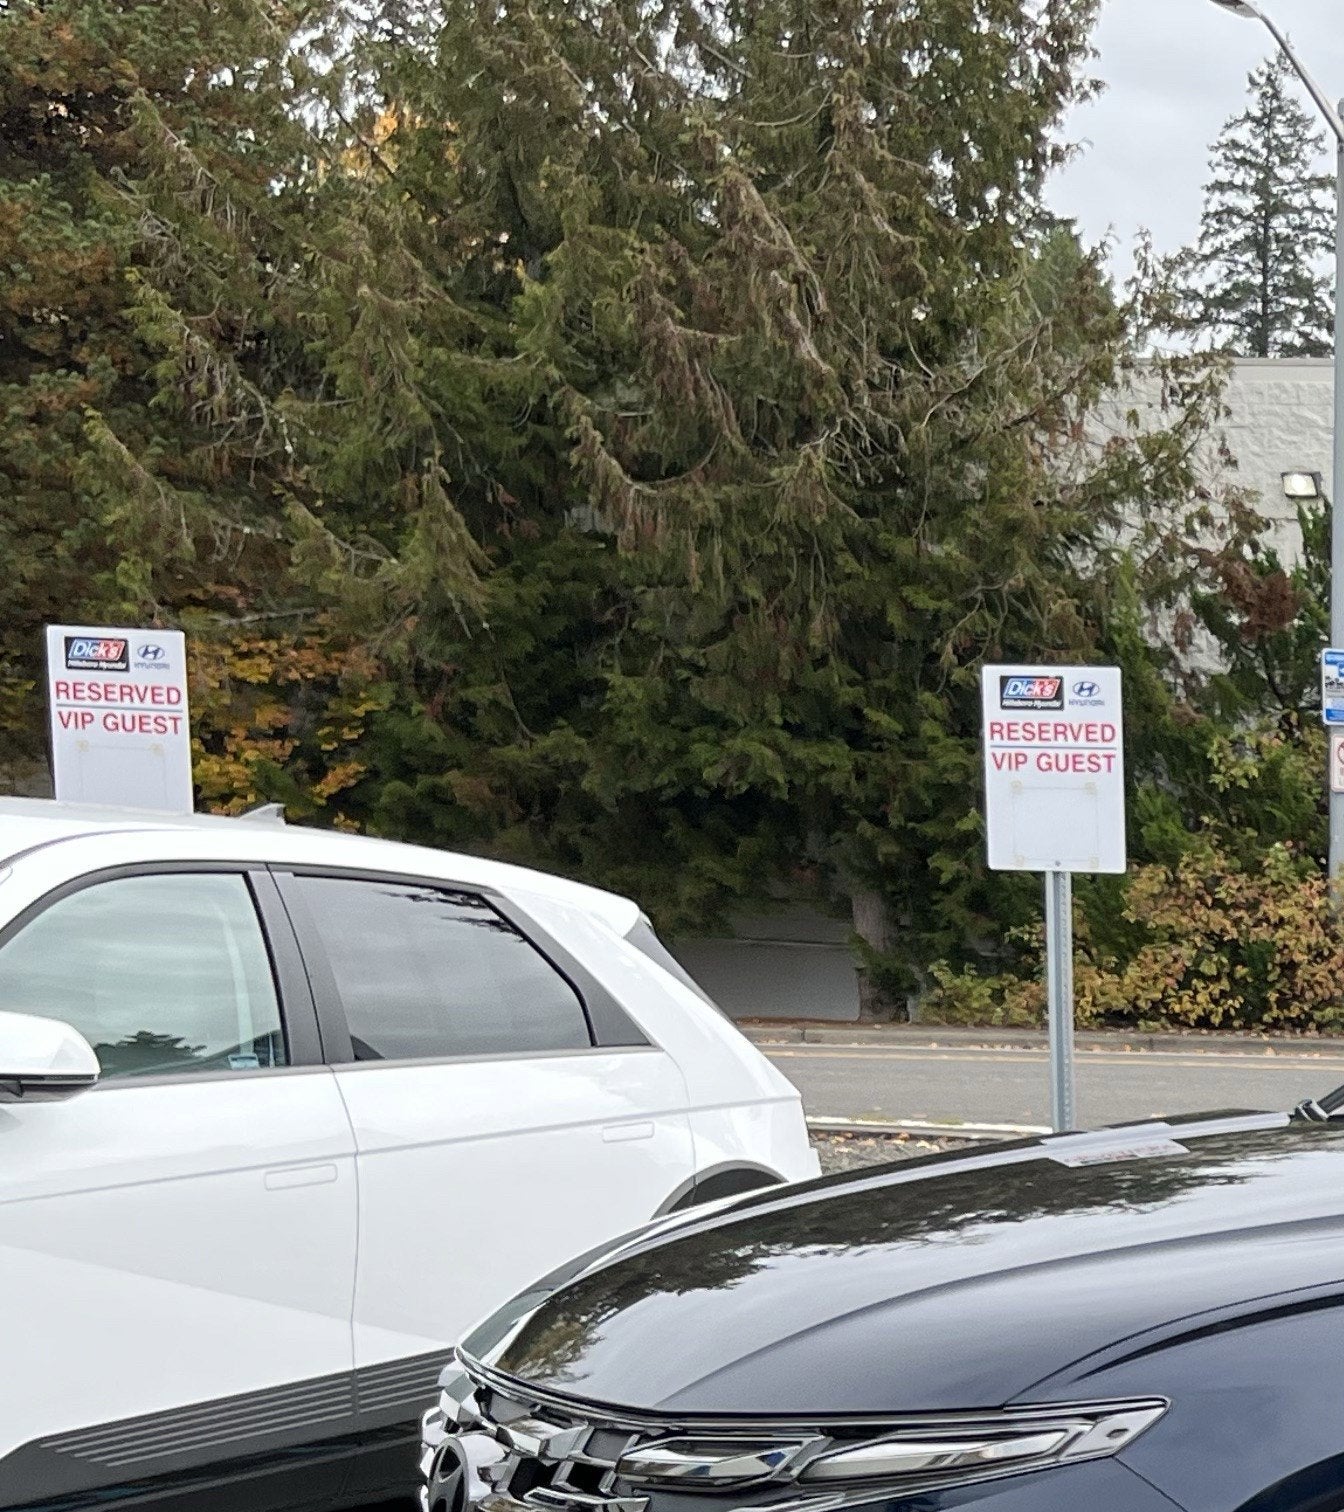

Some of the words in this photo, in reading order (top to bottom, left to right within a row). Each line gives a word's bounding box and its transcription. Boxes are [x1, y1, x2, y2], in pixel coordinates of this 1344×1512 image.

[55, 680, 182, 706] RESERVED
[57, 710, 95, 731] VIP
[102, 712, 183, 735] GUEST
[989, 722, 1116, 743] RESERVED
[991, 751, 1028, 771] VIP
[1036, 752, 1117, 773] GUEST
